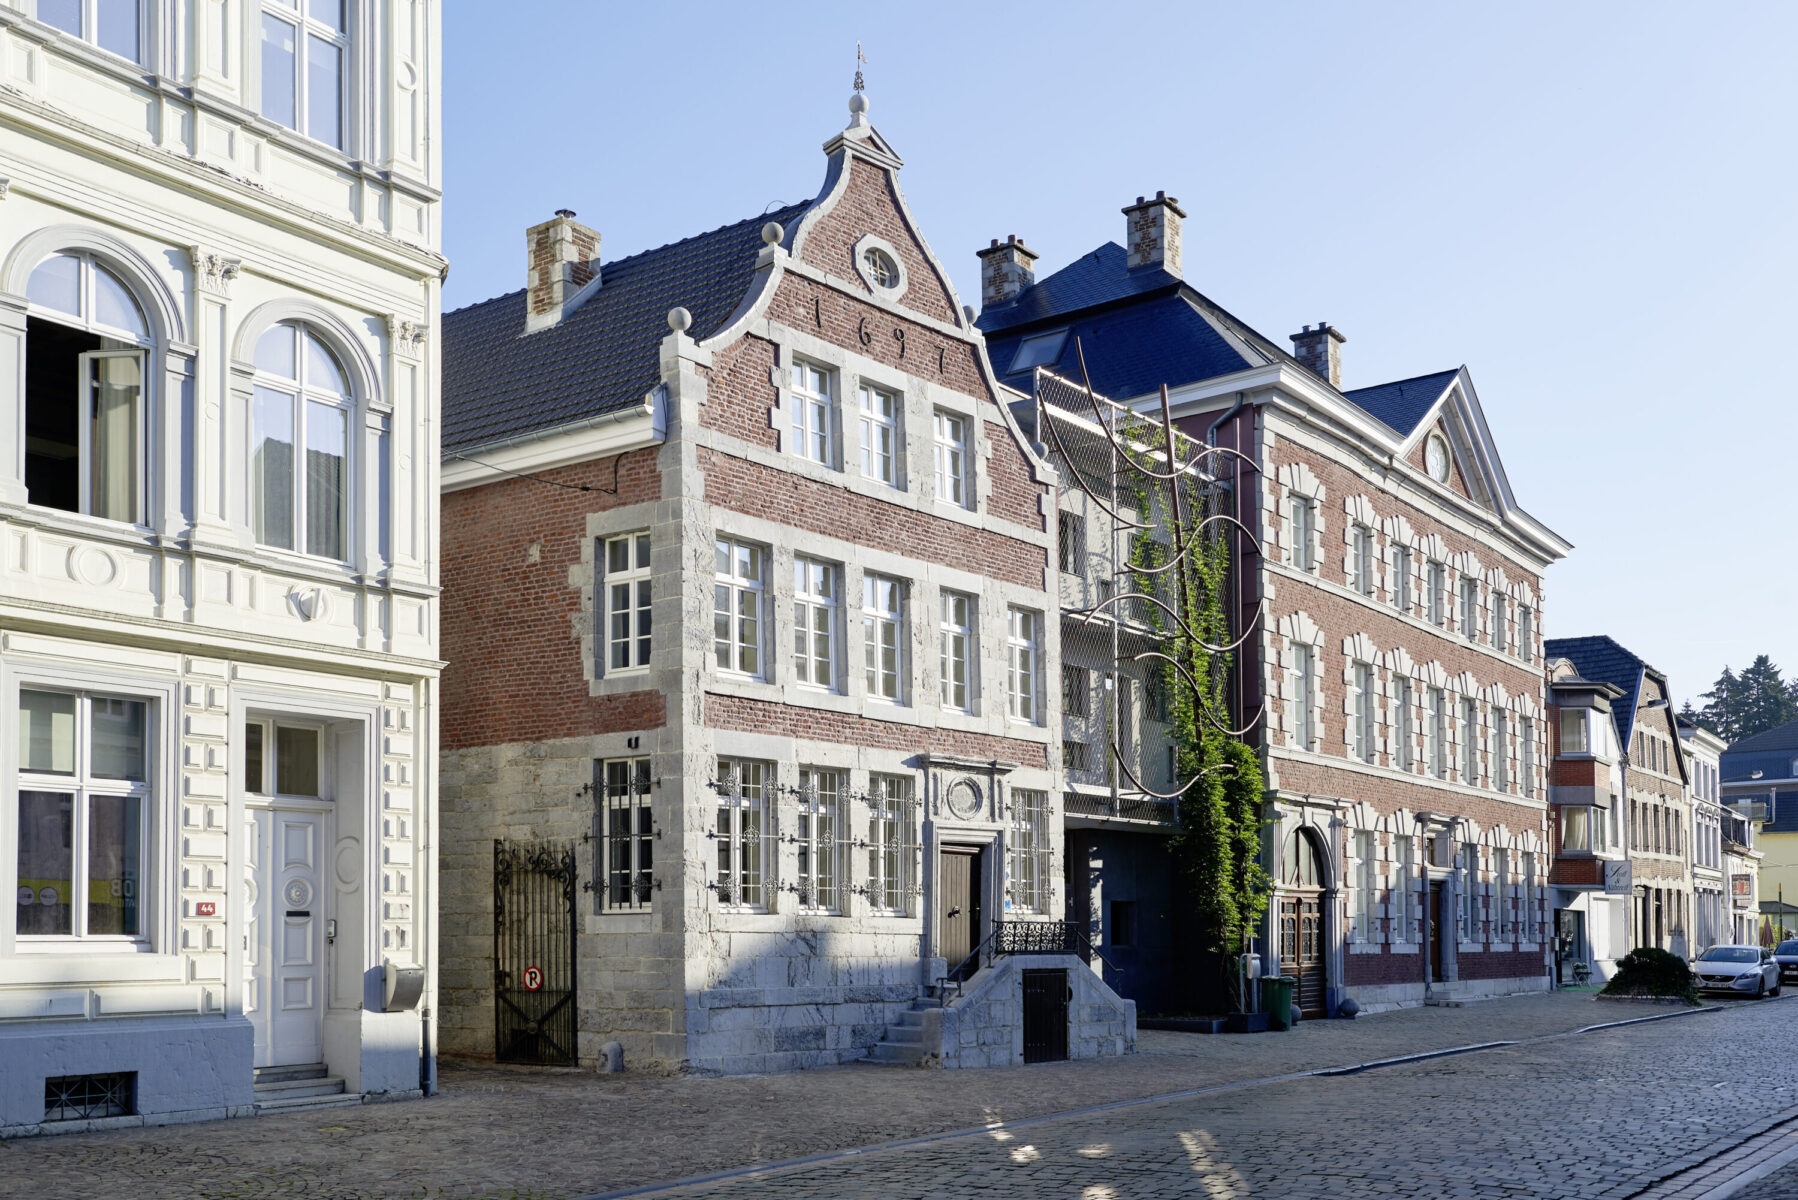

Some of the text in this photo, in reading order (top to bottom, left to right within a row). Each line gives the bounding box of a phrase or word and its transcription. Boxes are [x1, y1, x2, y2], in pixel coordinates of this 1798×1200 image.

[810, 295, 945, 375] 1697
[201, 903, 214, 913] 44
[529, 970, 538, 987] P
